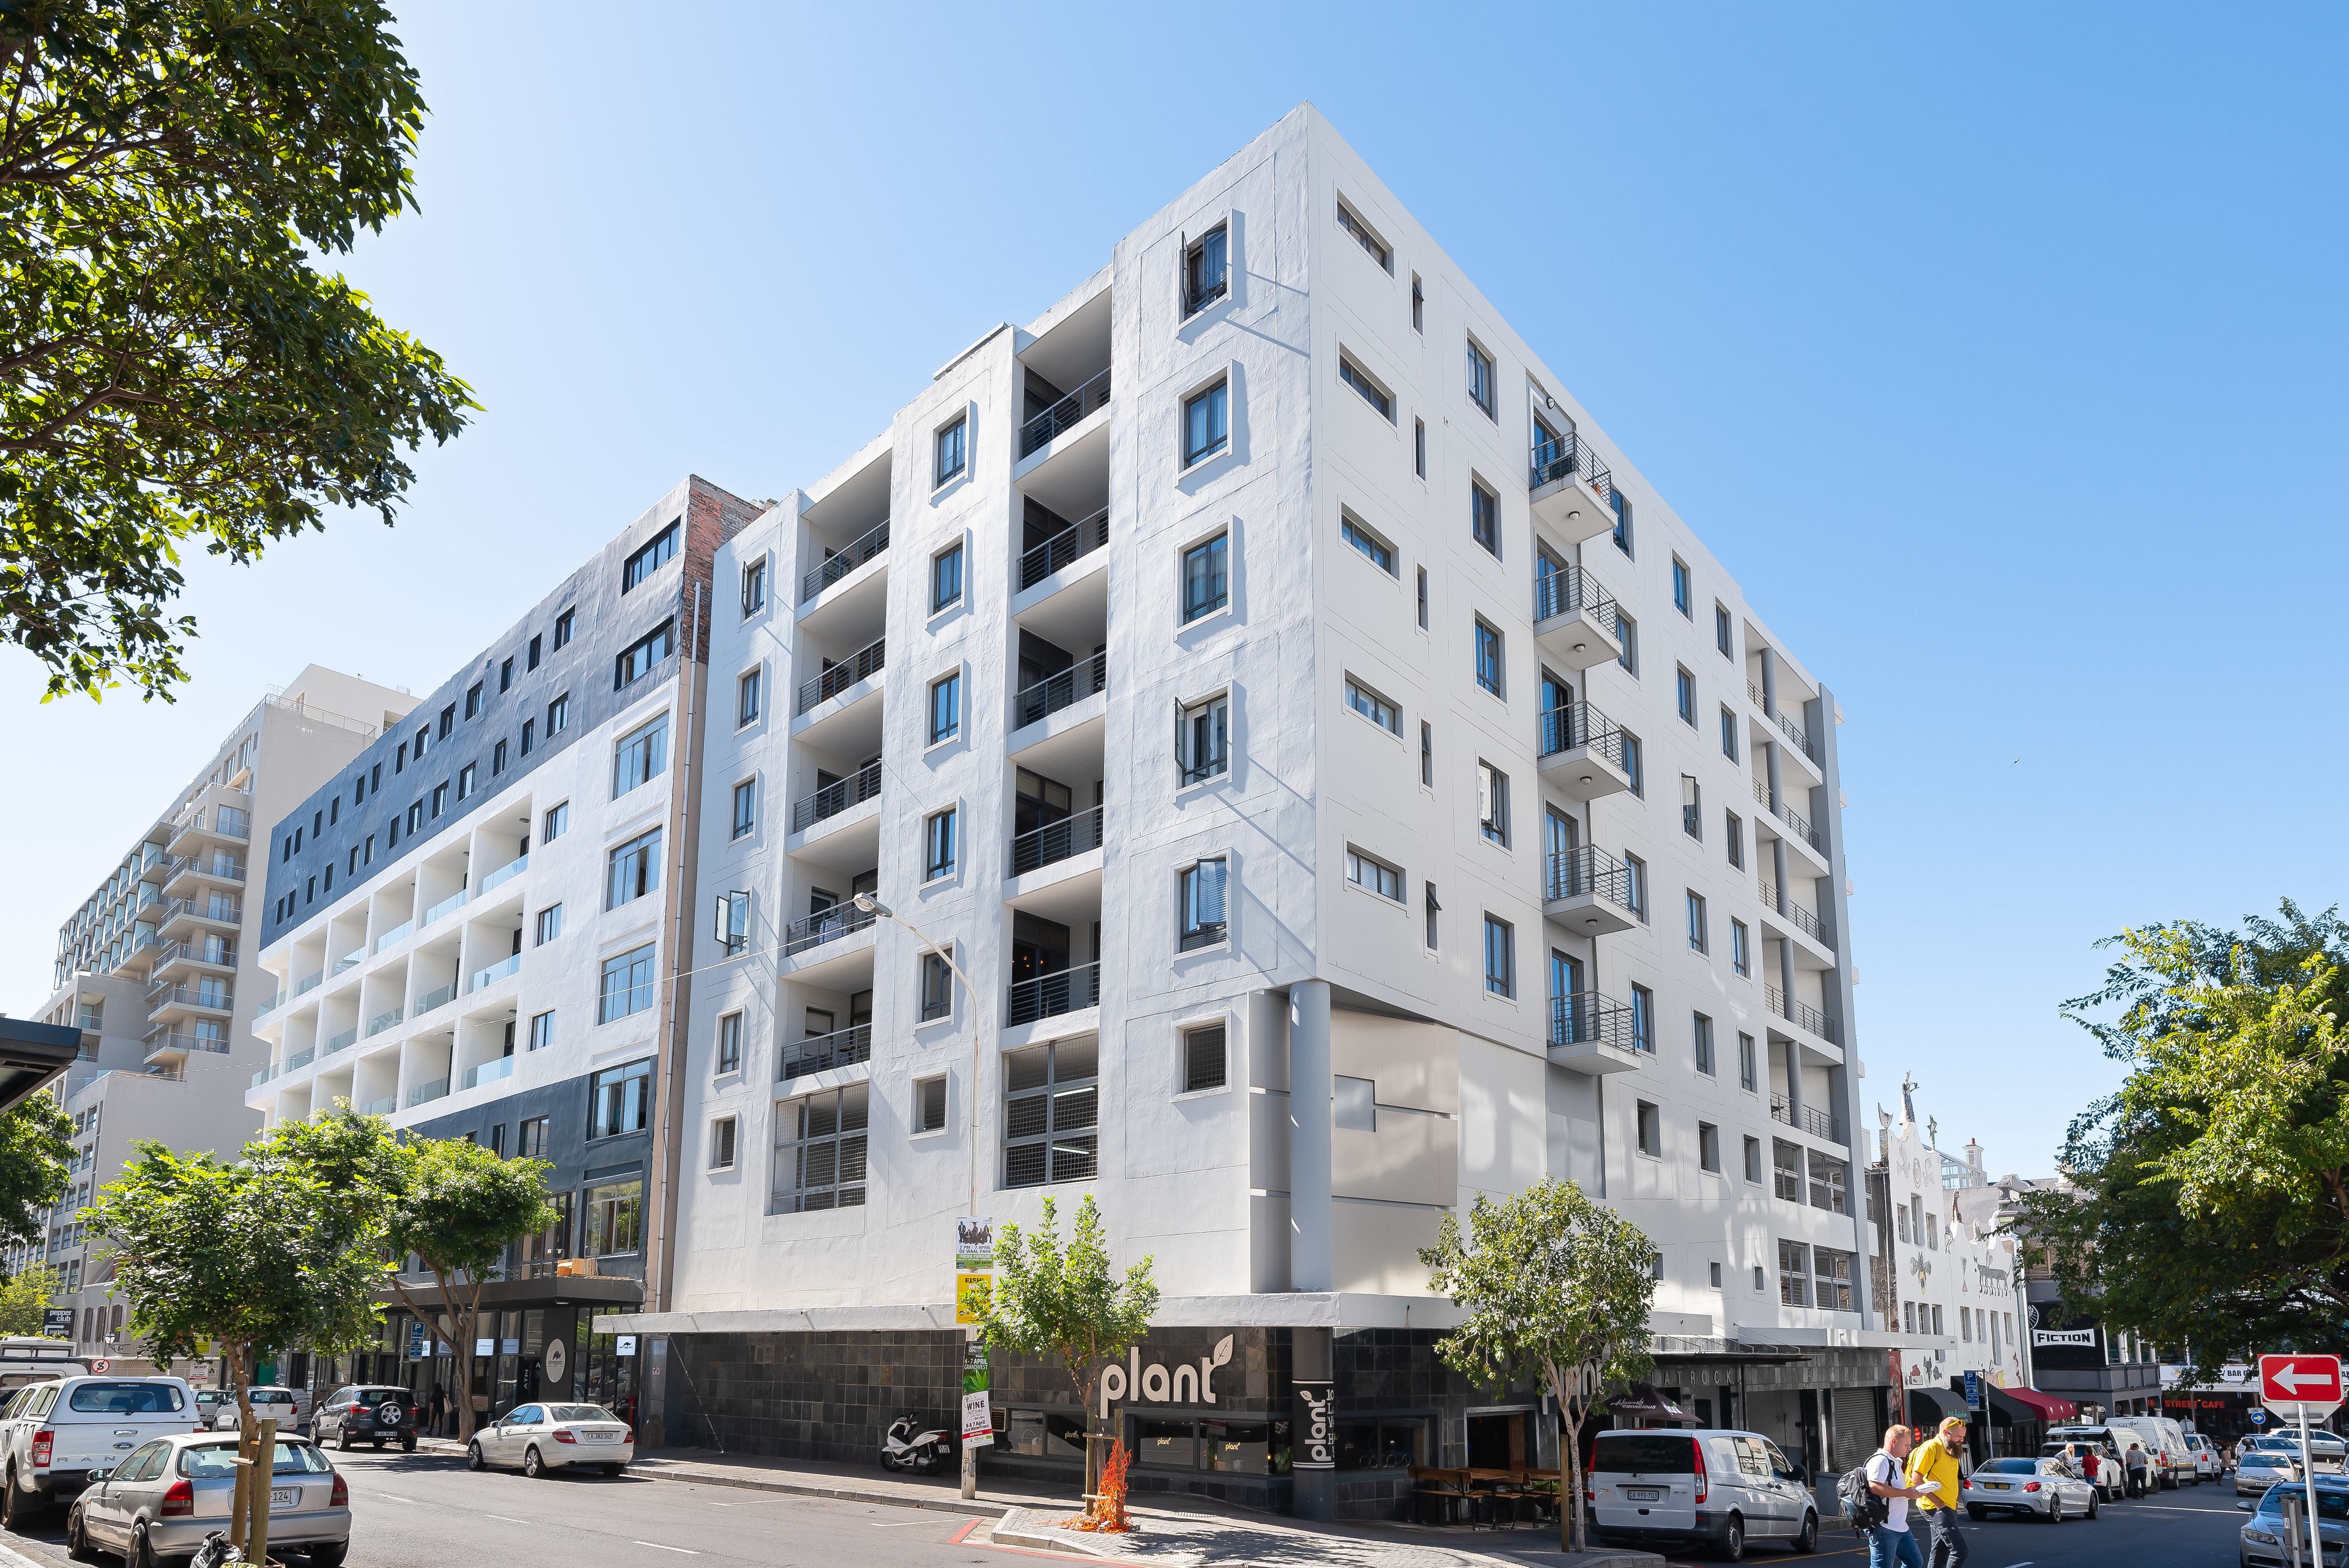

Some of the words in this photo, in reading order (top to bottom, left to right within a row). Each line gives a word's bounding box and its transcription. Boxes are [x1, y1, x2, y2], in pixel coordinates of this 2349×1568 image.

[2037, 1332, 2091, 1343] FICTION
[1100, 1334, 1233, 1419] plant
[967, 1400, 985, 1411] WINE
[2165, 1399, 2198, 1408] STREET
[1300, 1390, 1332, 1462] plant
[1064, 1430, 1080, 1440] plant
[1157, 1436, 1171, 1446] plant
[1225, 1442, 1241, 1451] plant
